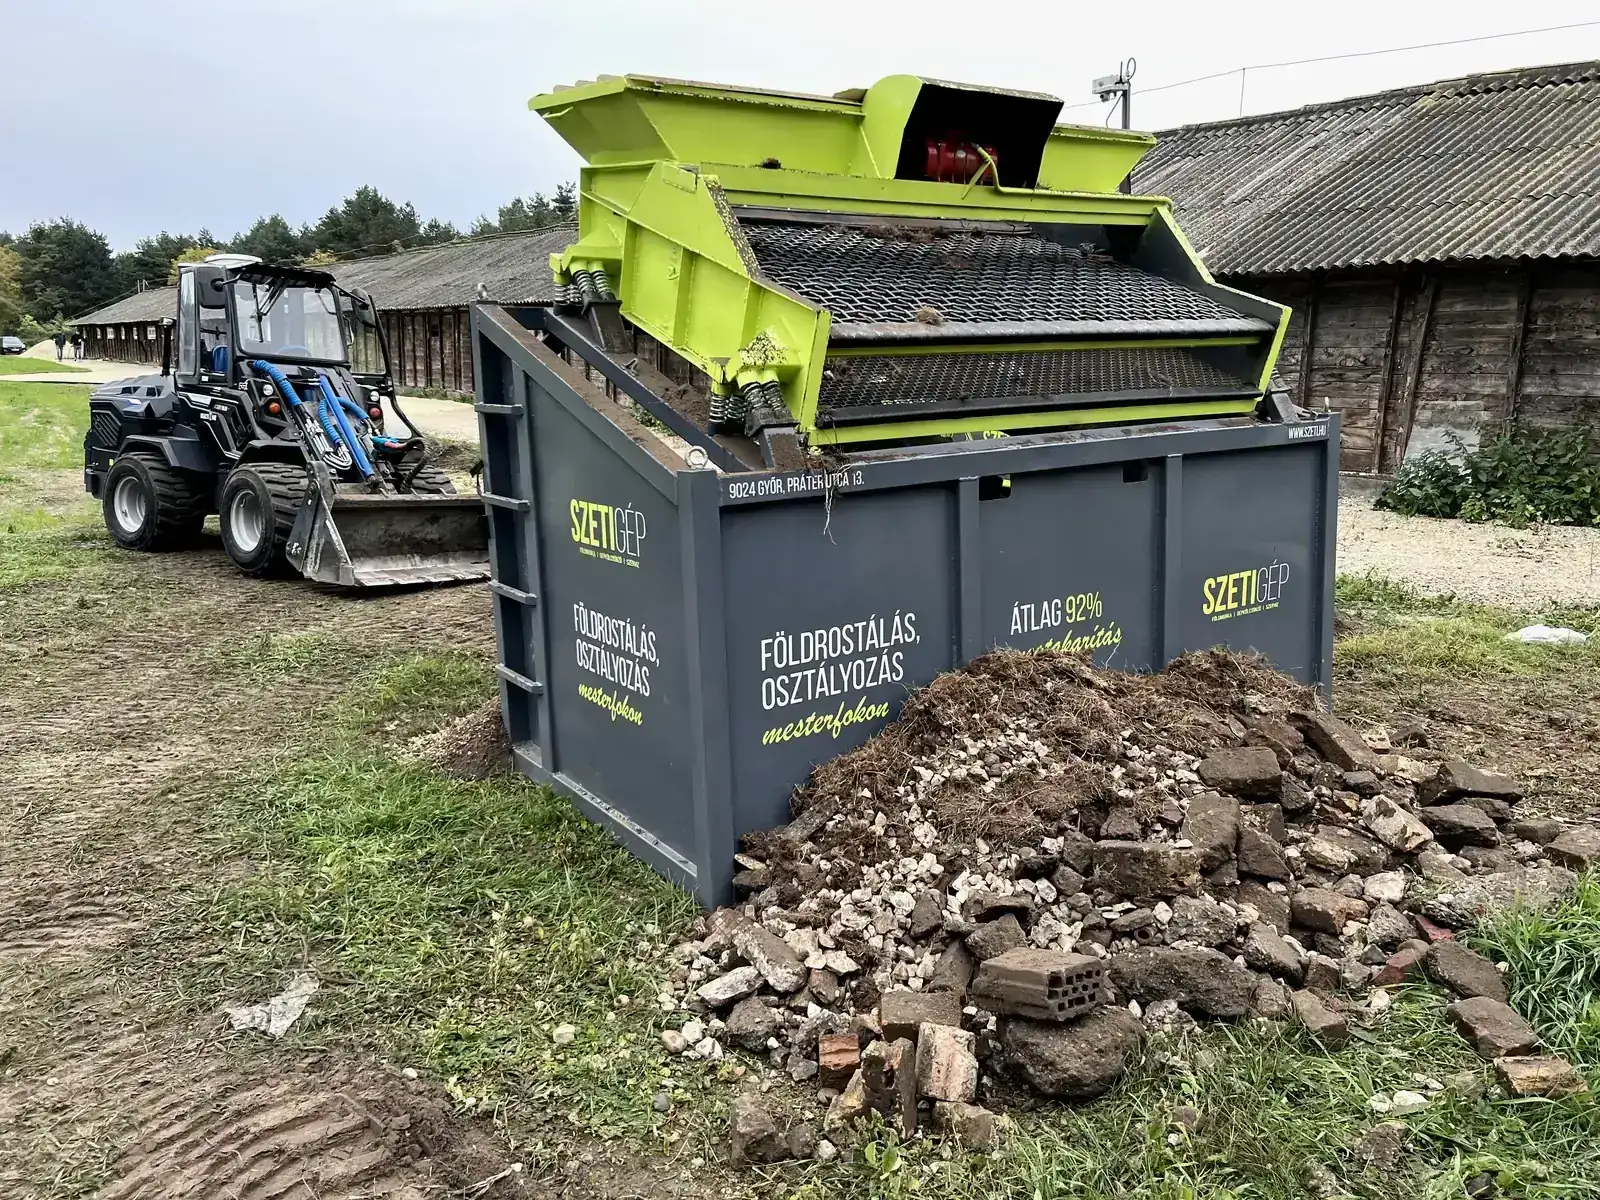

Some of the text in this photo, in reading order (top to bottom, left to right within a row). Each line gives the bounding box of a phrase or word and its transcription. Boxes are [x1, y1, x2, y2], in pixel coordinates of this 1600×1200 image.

[729, 482, 756, 499] 9024
[758, 476, 786, 495] GYŐR,
[787, 472, 824, 493] PRÁTER
[825, 471, 850, 488] UTCA
[570, 499, 647, 557] SZETIGÉP
[1010, 591, 1103, 636] ÁTLAG 92%
[1202, 558, 1290, 615] SZETIGÉP
[573, 601, 660, 667] FÖLDROSTÁLÁS,
[760, 609, 921, 672] FÖLDROSTÁLÁS,
[1022, 621, 1123, 657] takarítás
[576, 639, 651, 697] OSZTÁLYOZÁS
[761, 648, 905, 711] OSZTÁLYOZÁS
[578, 683, 644, 726] mesterfokon
[762, 695, 890, 746] mesterfokon
